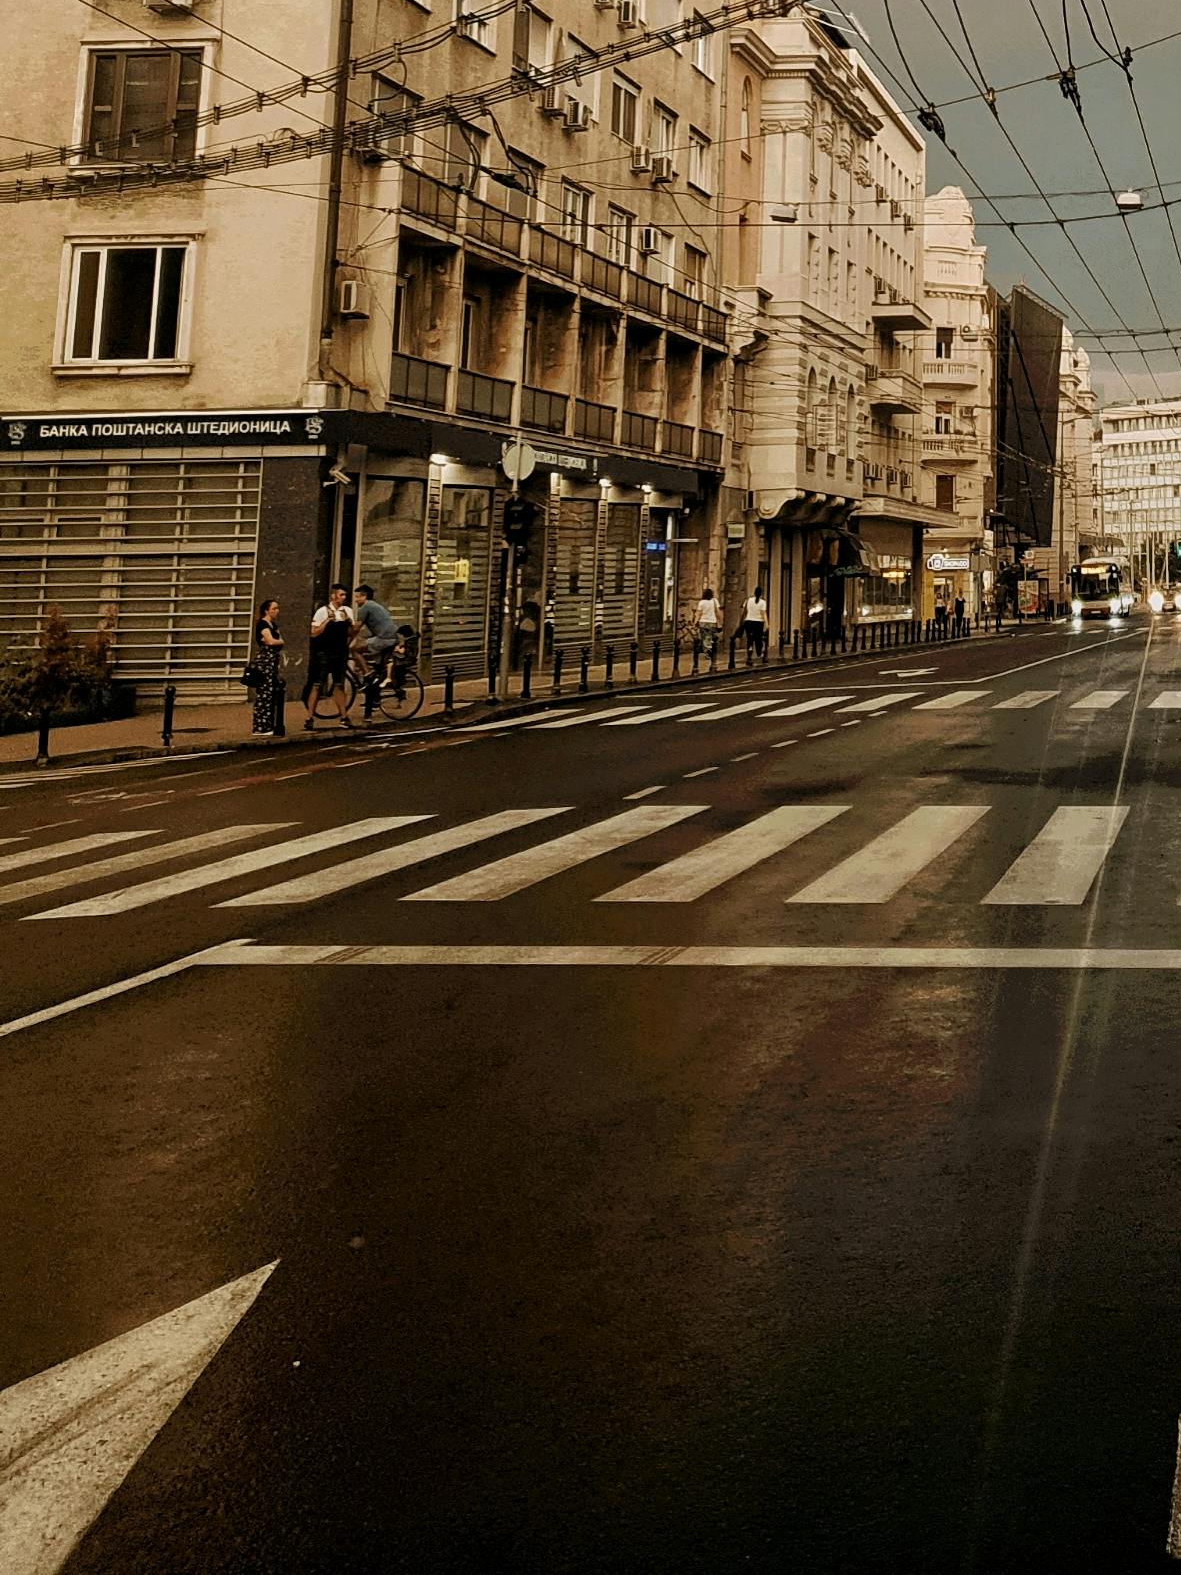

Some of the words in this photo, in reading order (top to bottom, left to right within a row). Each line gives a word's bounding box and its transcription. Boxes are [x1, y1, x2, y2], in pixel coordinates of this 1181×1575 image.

[40, 425, 88, 437] БАНКА
[92, 422, 184, 436] ПОШТАНСКА
[187, 420, 291, 435] ШТЕДИОНИЦА
